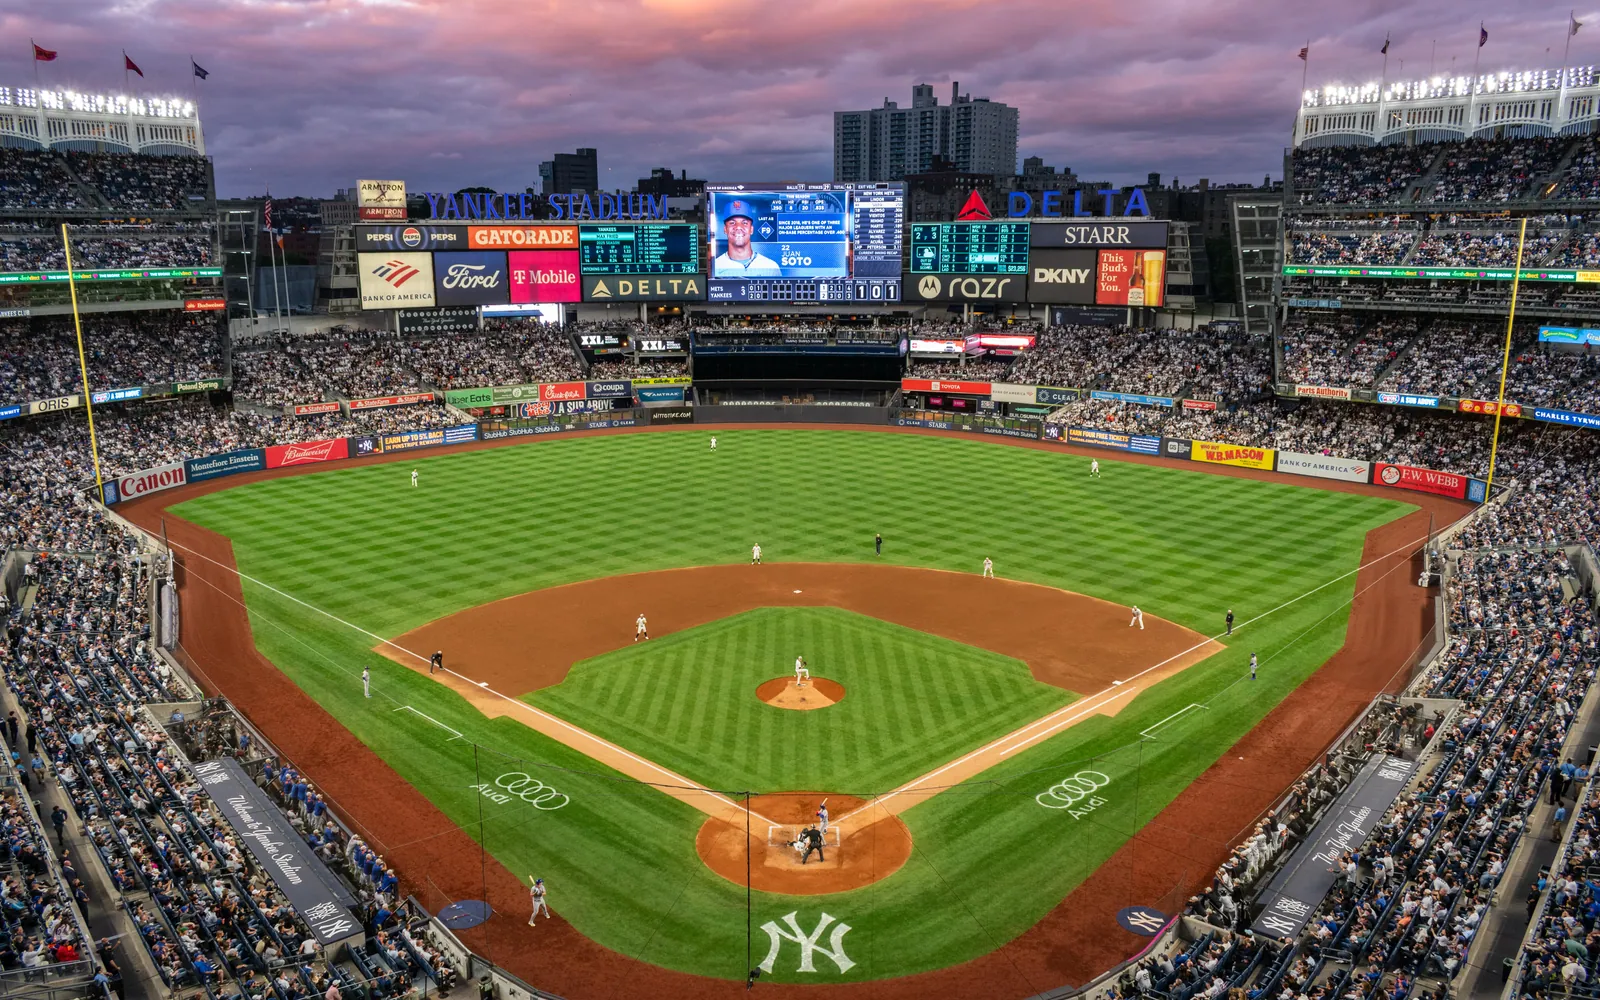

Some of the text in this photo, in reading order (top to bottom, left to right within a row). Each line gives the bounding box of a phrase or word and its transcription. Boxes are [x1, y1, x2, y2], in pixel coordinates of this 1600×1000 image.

[424, 192, 669, 220] YANKEE STADIUM
[1008, 188, 1150, 217] DELTA
[475, 230, 573, 246] GATORADE
[1065, 226, 1131, 244] STARR
[782, 257, 812, 266] SOTO
[1102, 252, 1124, 262] This
[1102, 262, 1127, 272] Bud's
[442, 264, 500, 288] Ford
[529, 270, 576, 285] Mobile
[1034, 268, 1090, 284] DKNY
[1101, 273, 1117, 282] For
[619, 280, 699, 296] DELTA
[859, 286, 894, 298] 1 0 1
[949, 278, 1011, 298] razr
[1101, 282, 1121, 292] You.
[581, 336, 604, 345] XXL
[641, 341, 665, 350] XXL
[178, 382, 218, 391] Poland Spring
[1316, 388, 1348, 397] Authority
[38, 398, 69, 411] ORIS
[470, 394, 491, 403] Eats
[559, 402, 565, 413] A
[587, 400, 614, 410] ABOVE
[1535, 411, 1570, 421] CHARLES
[509, 429, 533, 437] StubHub
[287, 449, 329, 459] Budweiser
[191, 460, 228, 472] Montefiore
[229, 454, 258, 464] Einstein
[1313, 464, 1348, 473] AMERICA
[121, 468, 184, 497] Canon
[1402, 469, 1422, 481] F.W.
[1426, 472, 1459, 488] WEBB
[469, 783, 512, 805] Audi
[1067, 796, 1108, 820] Audi
[227, 794, 302, 885] Welcome to Yankee Stadium
[1312, 806, 1371, 864] New York Yankees
[1127, 911, 1165, 933] NY
[760, 911, 856, 974] NY
